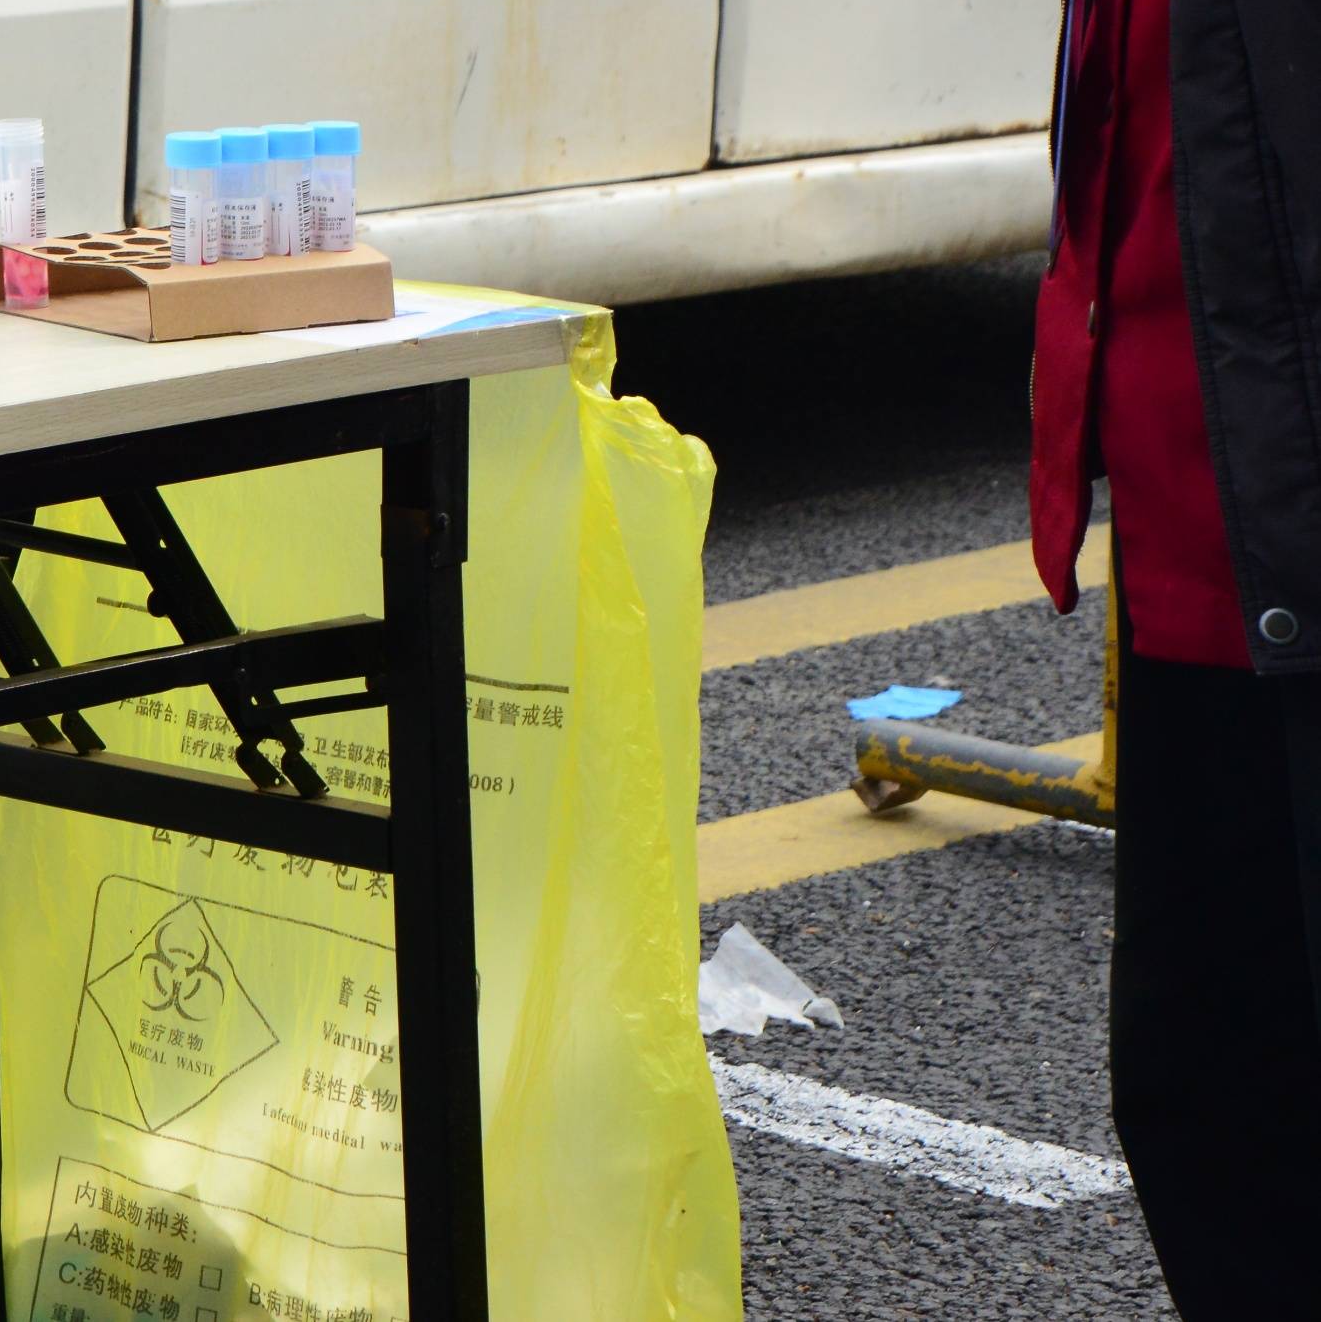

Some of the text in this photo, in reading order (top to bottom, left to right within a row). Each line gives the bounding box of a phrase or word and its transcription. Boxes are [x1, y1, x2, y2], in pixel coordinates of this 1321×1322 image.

[339, 975, 383, 1017] 警告
[140, 1018, 204, 1052] 医疗废物
[177, 1056, 217, 1078] WASTE
[380, 1139, 403, 1153] wa
